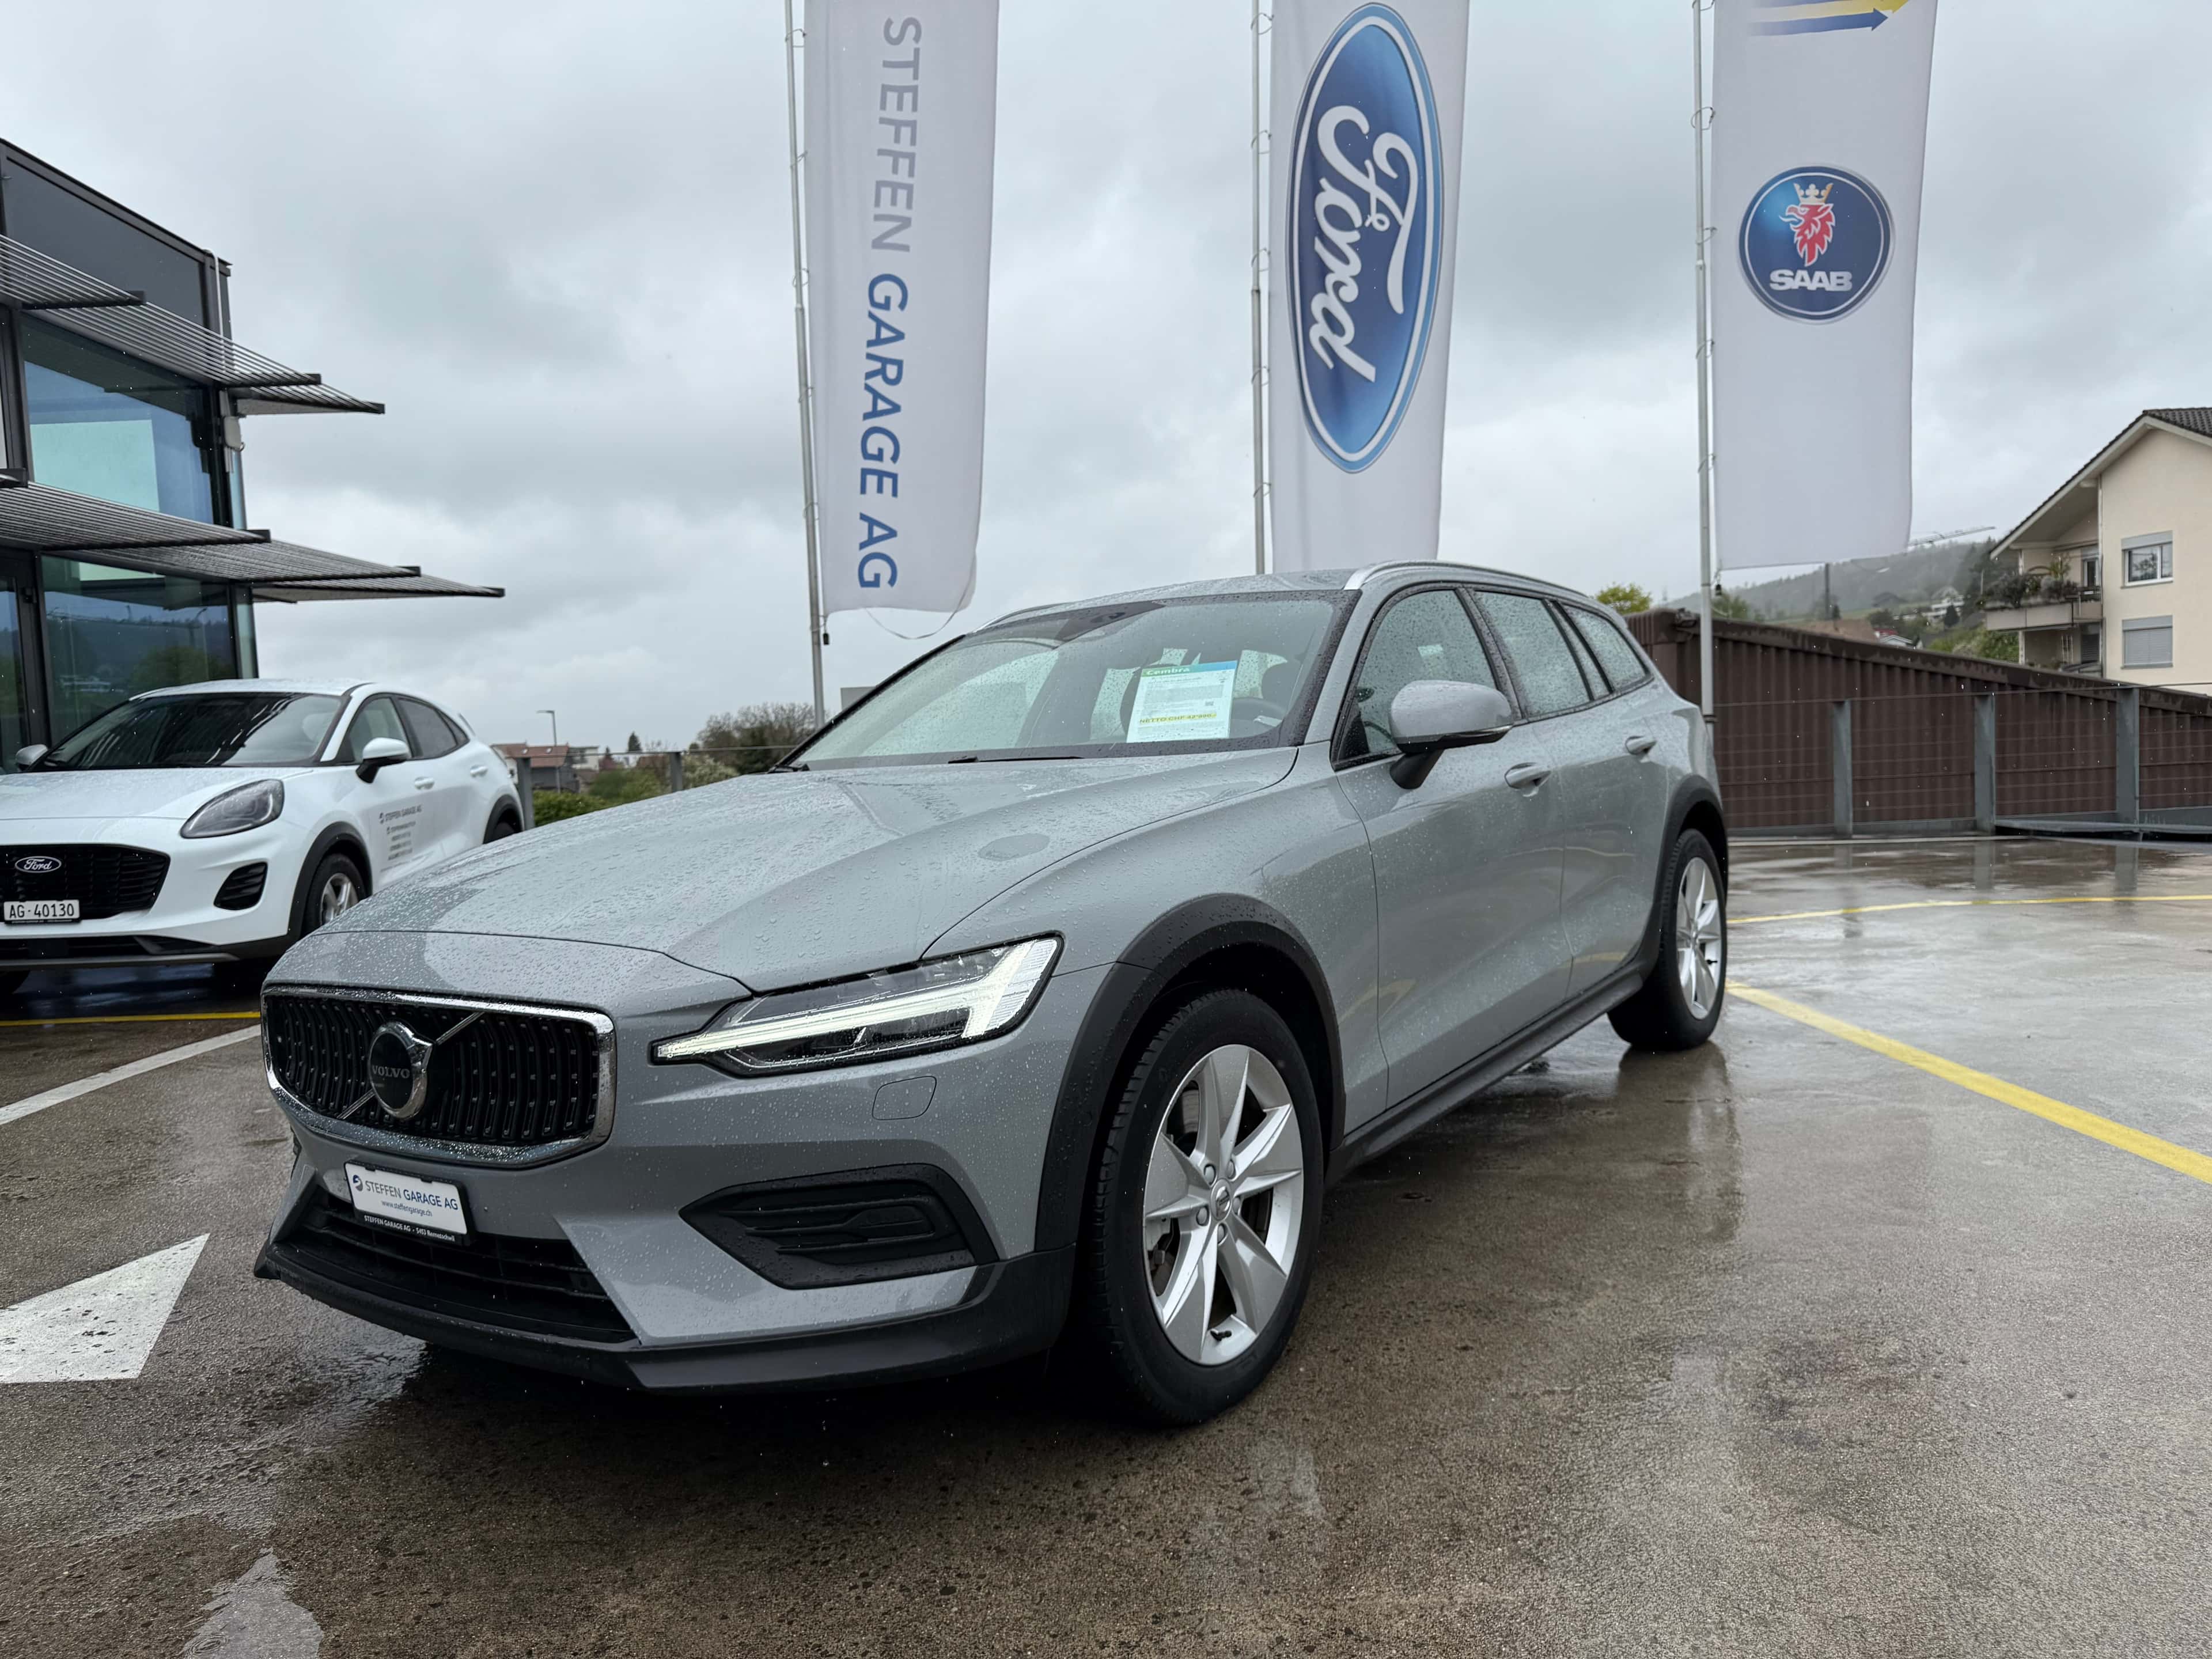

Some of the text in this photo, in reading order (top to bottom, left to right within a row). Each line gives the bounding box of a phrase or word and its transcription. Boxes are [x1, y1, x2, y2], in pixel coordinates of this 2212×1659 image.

[1309, 105, 1418, 382] Ford
[1770, 269, 1853, 291] SAAB
[859, 17, 922, 588] STEFFEN GARAGE AG
[1146, 667, 1190, 675] Cembra
[24, 858, 52, 870] Ford
[9, 903, 74, 918] AG 40130
[372, 1066, 410, 1078] VOLVO
[365, 1180, 458, 1210] STEFFEN GARAGE AG
[364, 1215, 384, 1225] STEFFEN
[384, 1220, 403, 1230] GARAGE
